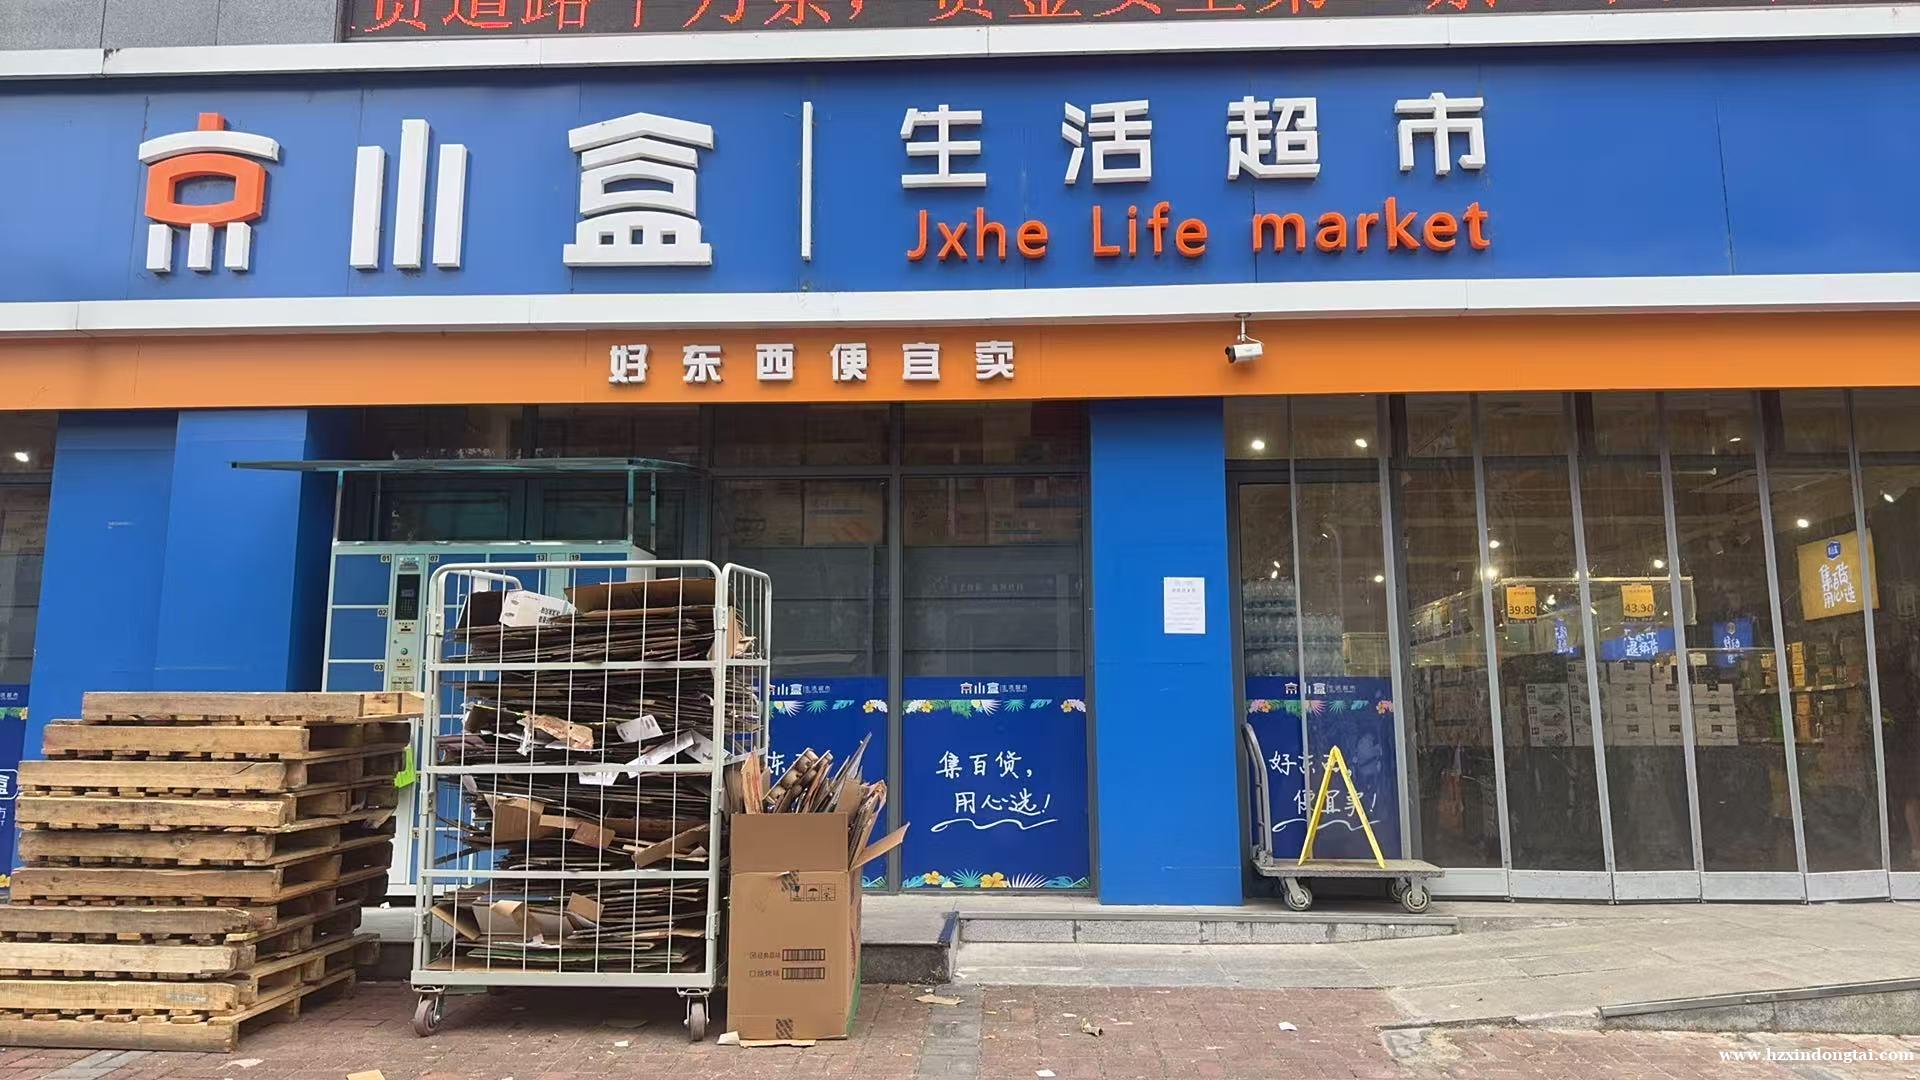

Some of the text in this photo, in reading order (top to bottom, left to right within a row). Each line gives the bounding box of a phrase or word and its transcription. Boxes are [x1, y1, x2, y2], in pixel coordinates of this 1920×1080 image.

[900, 92, 1486, 188] 生活超市
[138, 112, 714, 273] 京小盒
[907, 196, 1492, 262] Jxhe Life market
[608, 341, 1015, 383] 好东西便宜卖
[1508, 605, 1536, 615] 39.80
[1624, 603, 1654, 613] 43.90
[936, 751, 1032, 779] 集百货，
[955, 788, 1050, 816] 用心选！
